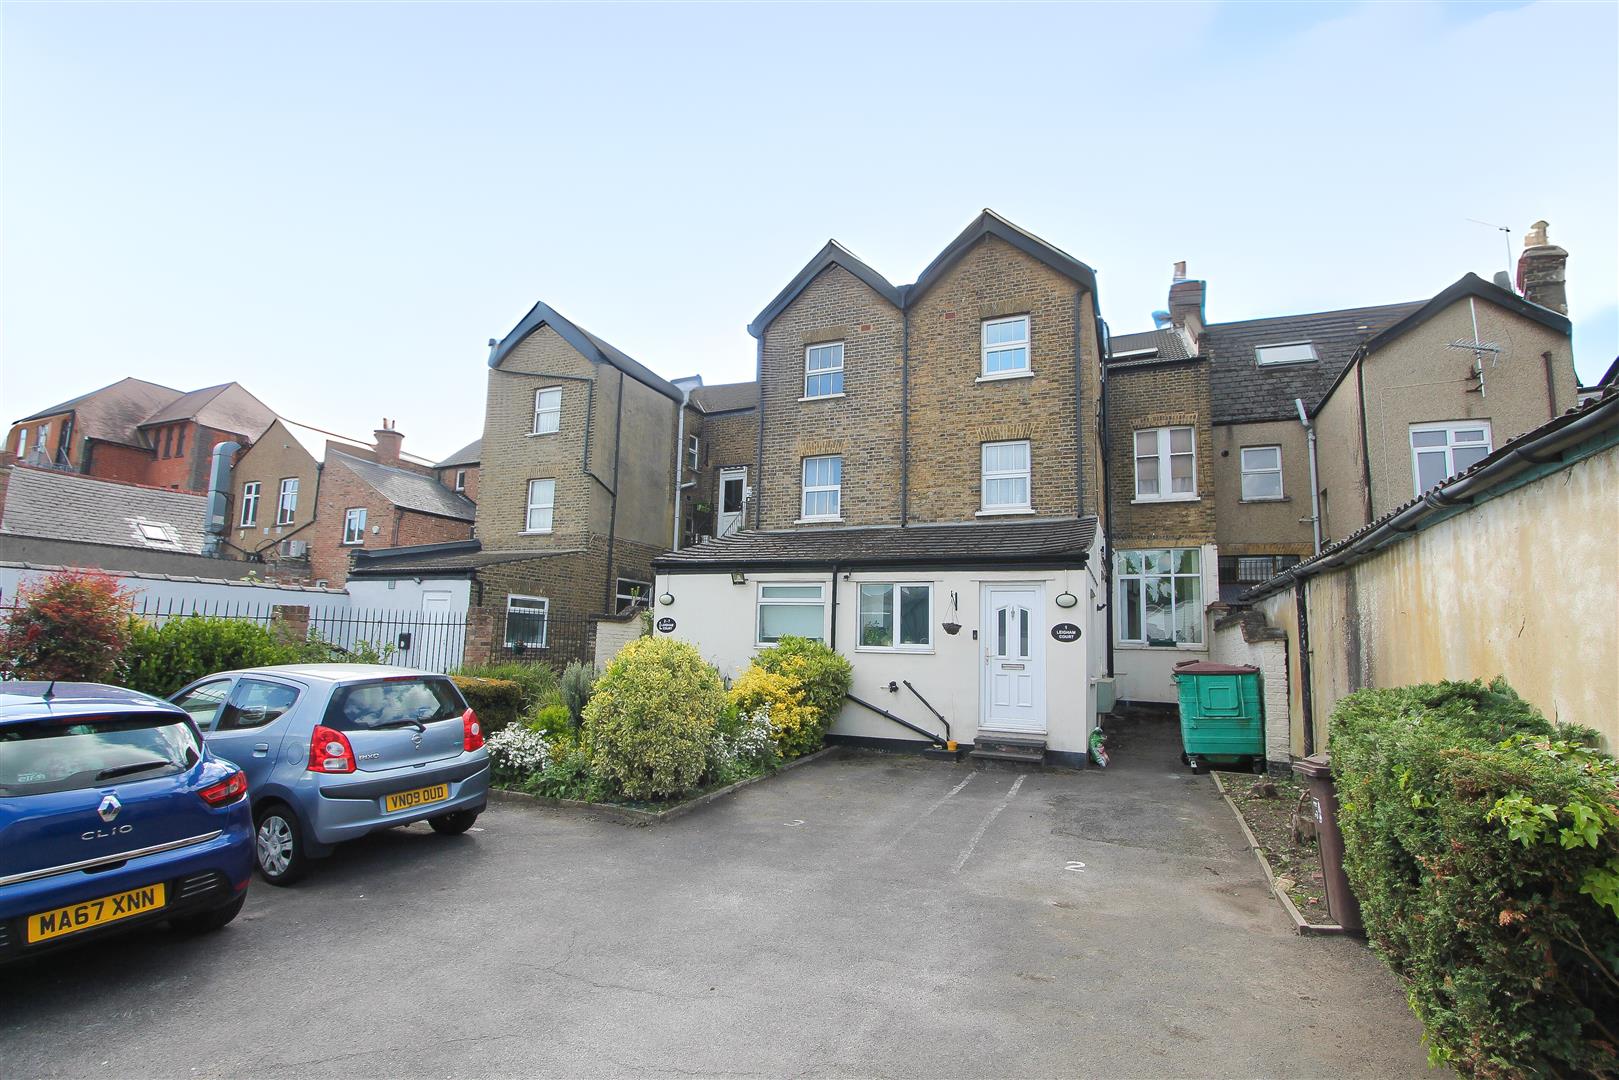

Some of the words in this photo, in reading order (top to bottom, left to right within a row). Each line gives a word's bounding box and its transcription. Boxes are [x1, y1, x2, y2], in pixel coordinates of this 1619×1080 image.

[391, 791, 420, 808] VN09
[423, 786, 444, 801] OUD
[1064, 861, 1085, 872] 2
[40, 901, 105, 936] MA67
[112, 888, 155, 916] XNN
